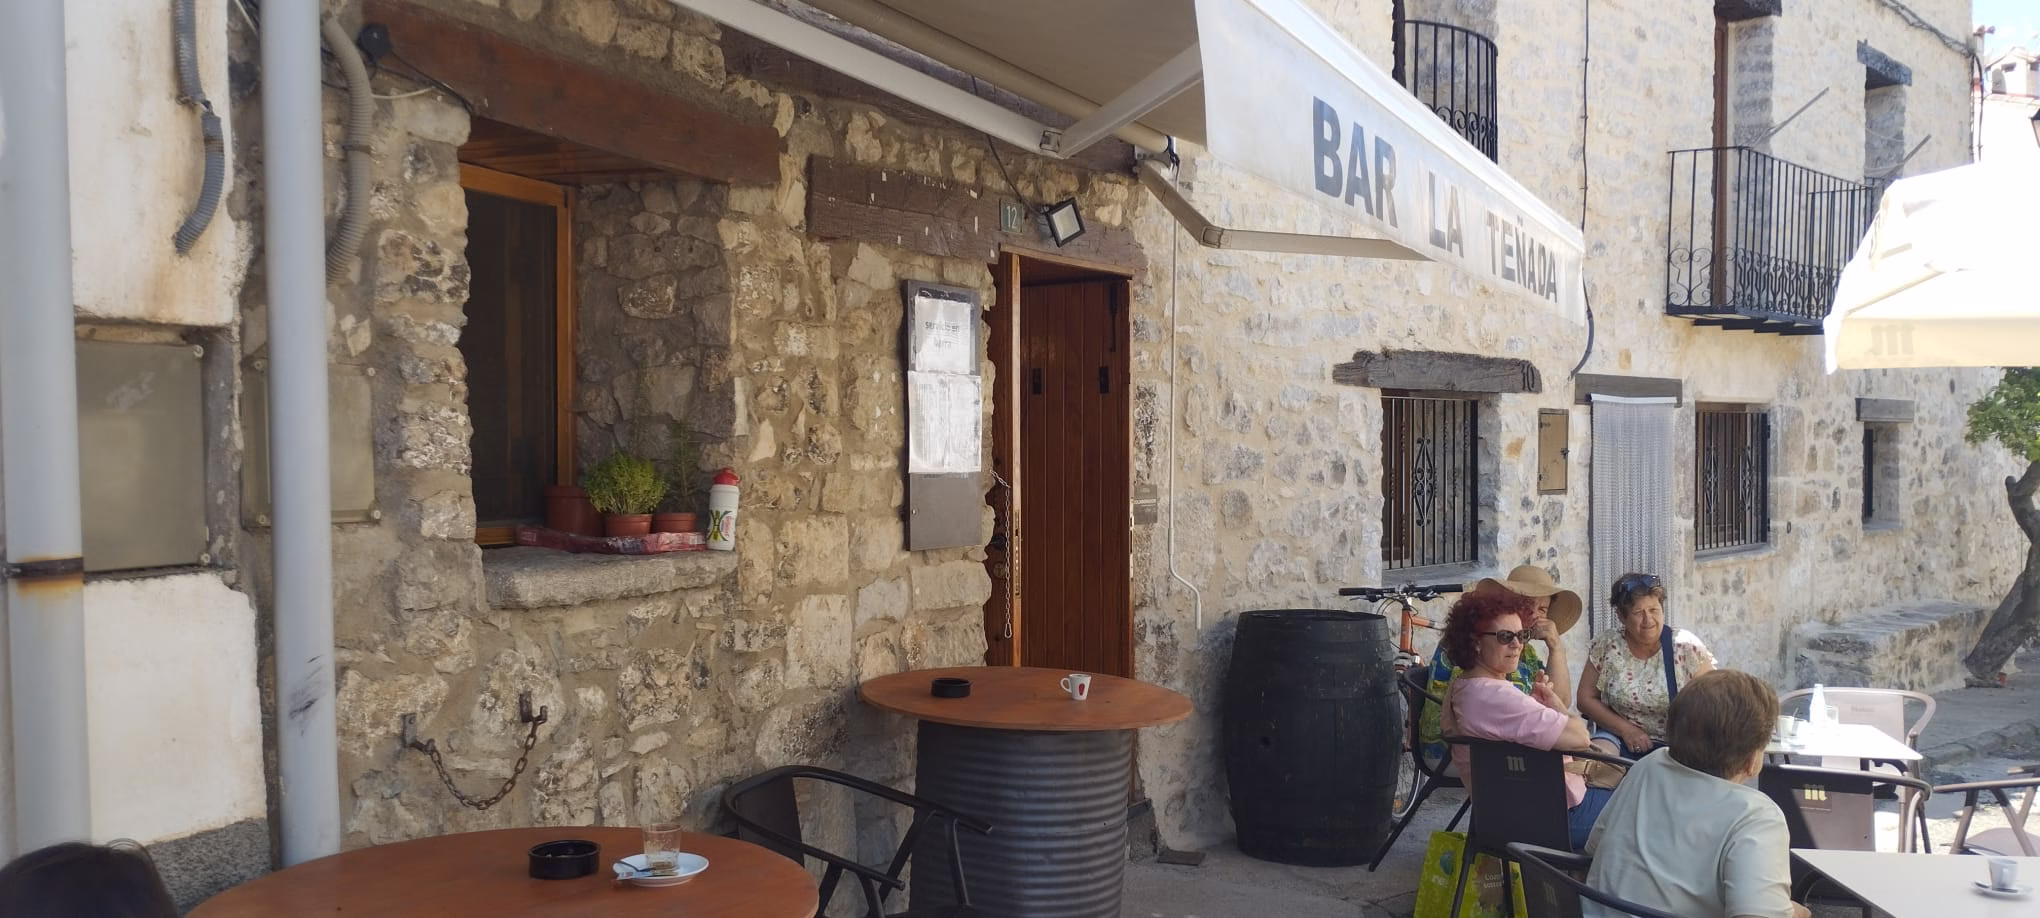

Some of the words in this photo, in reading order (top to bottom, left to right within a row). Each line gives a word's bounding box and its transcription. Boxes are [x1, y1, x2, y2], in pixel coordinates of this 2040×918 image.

[1006, 205, 1018, 229] 12
[1312, 96, 1398, 229] BAR
[1428, 170, 1464, 258] LA
[1486, 210, 1558, 303] TEÑADA
